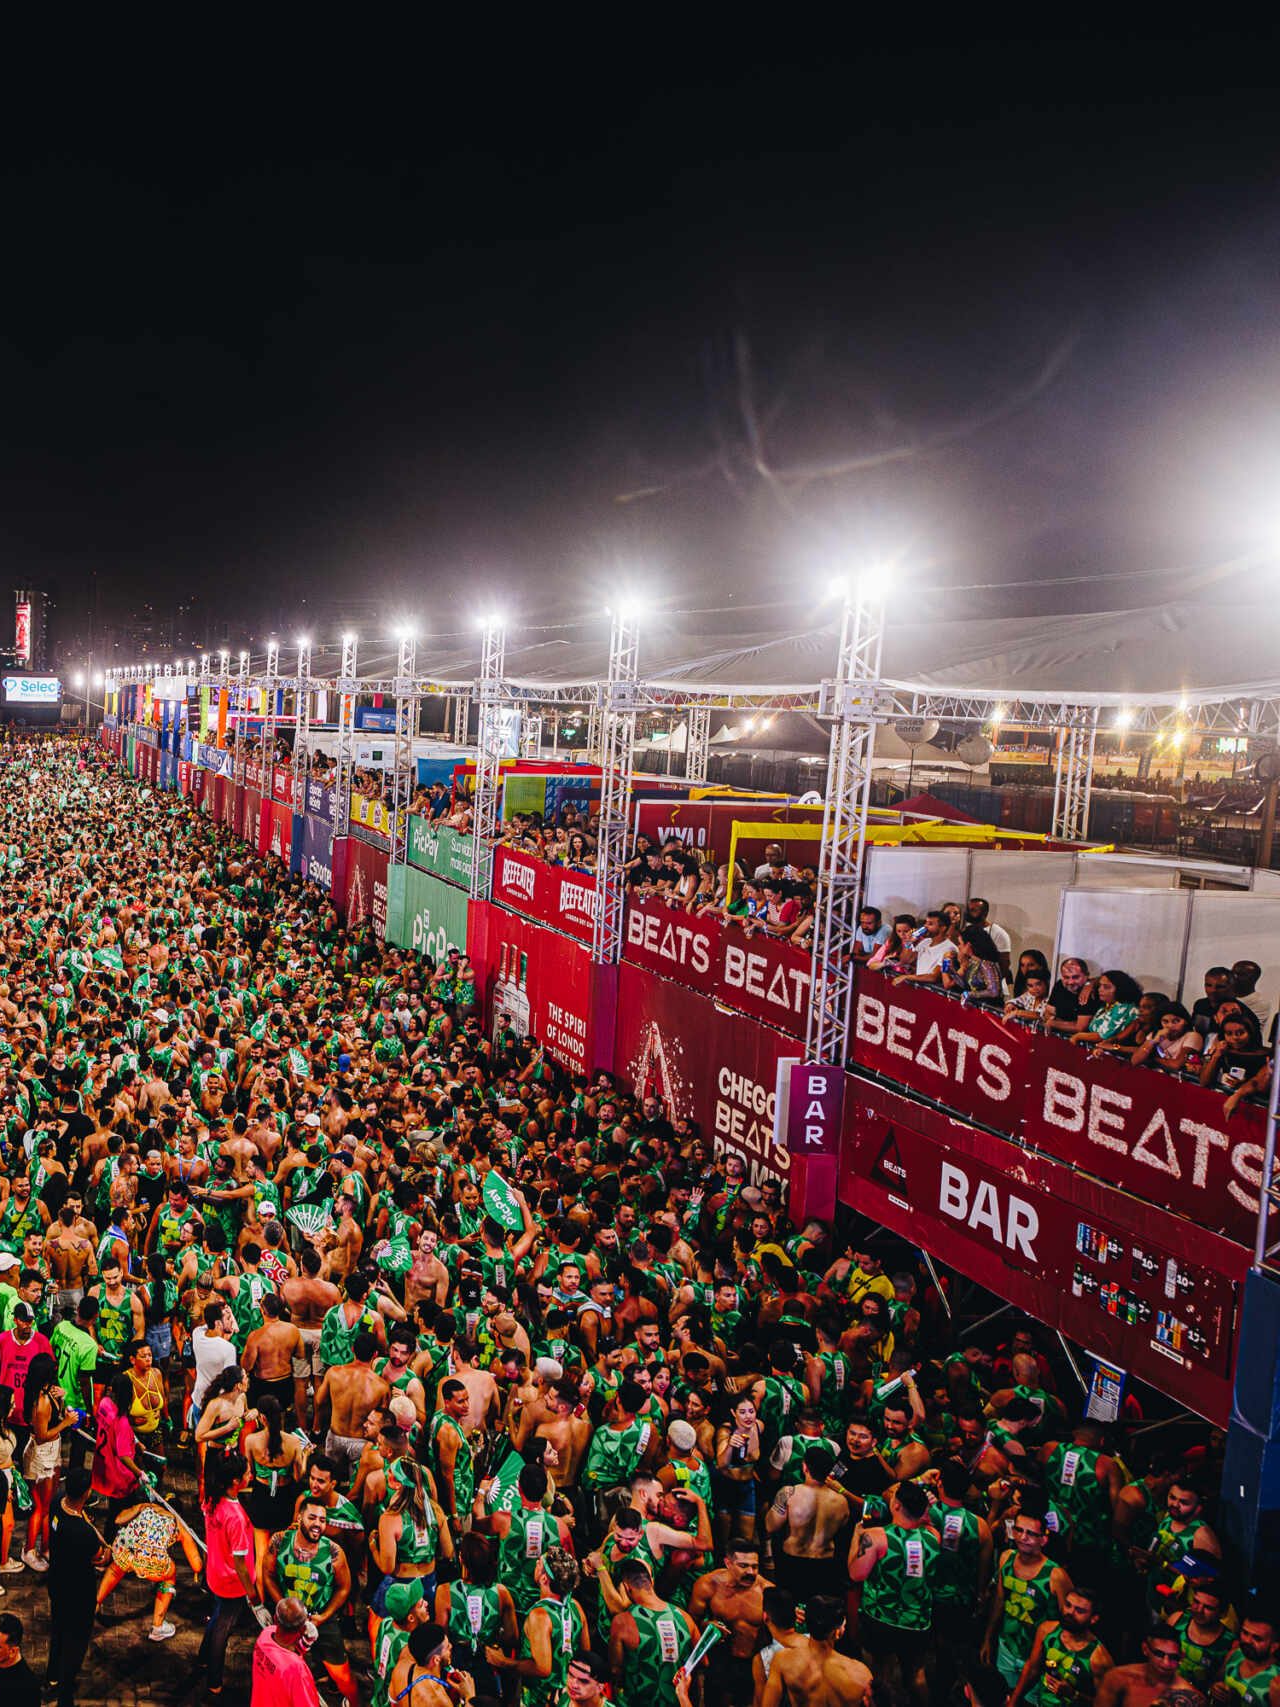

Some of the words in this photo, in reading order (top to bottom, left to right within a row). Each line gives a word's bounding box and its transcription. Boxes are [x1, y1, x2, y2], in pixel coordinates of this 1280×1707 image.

[414, 828, 440, 865] PicPay
[501, 858, 536, 901] BEEFEATER
[627, 909, 710, 973] BEATS
[547, 1023, 557, 1040] OF
[557, 1029, 585, 1058] LONDO
[548, 1001, 562, 1025] THE
[564, 1011, 587, 1039] SPIRI
[552, 1046, 569, 1067] SINCE
[856, 993, 1011, 1101] BEATS
[804, 1075, 827, 1145] BAR
[714, 1100, 791, 1170] BEATS
[1042, 1066, 1280, 1216] BEATS
[883, 1159, 907, 1179] BEATS
[486, 1189, 517, 1226] PicPay
[938, 1160, 1039, 1263] BAR
